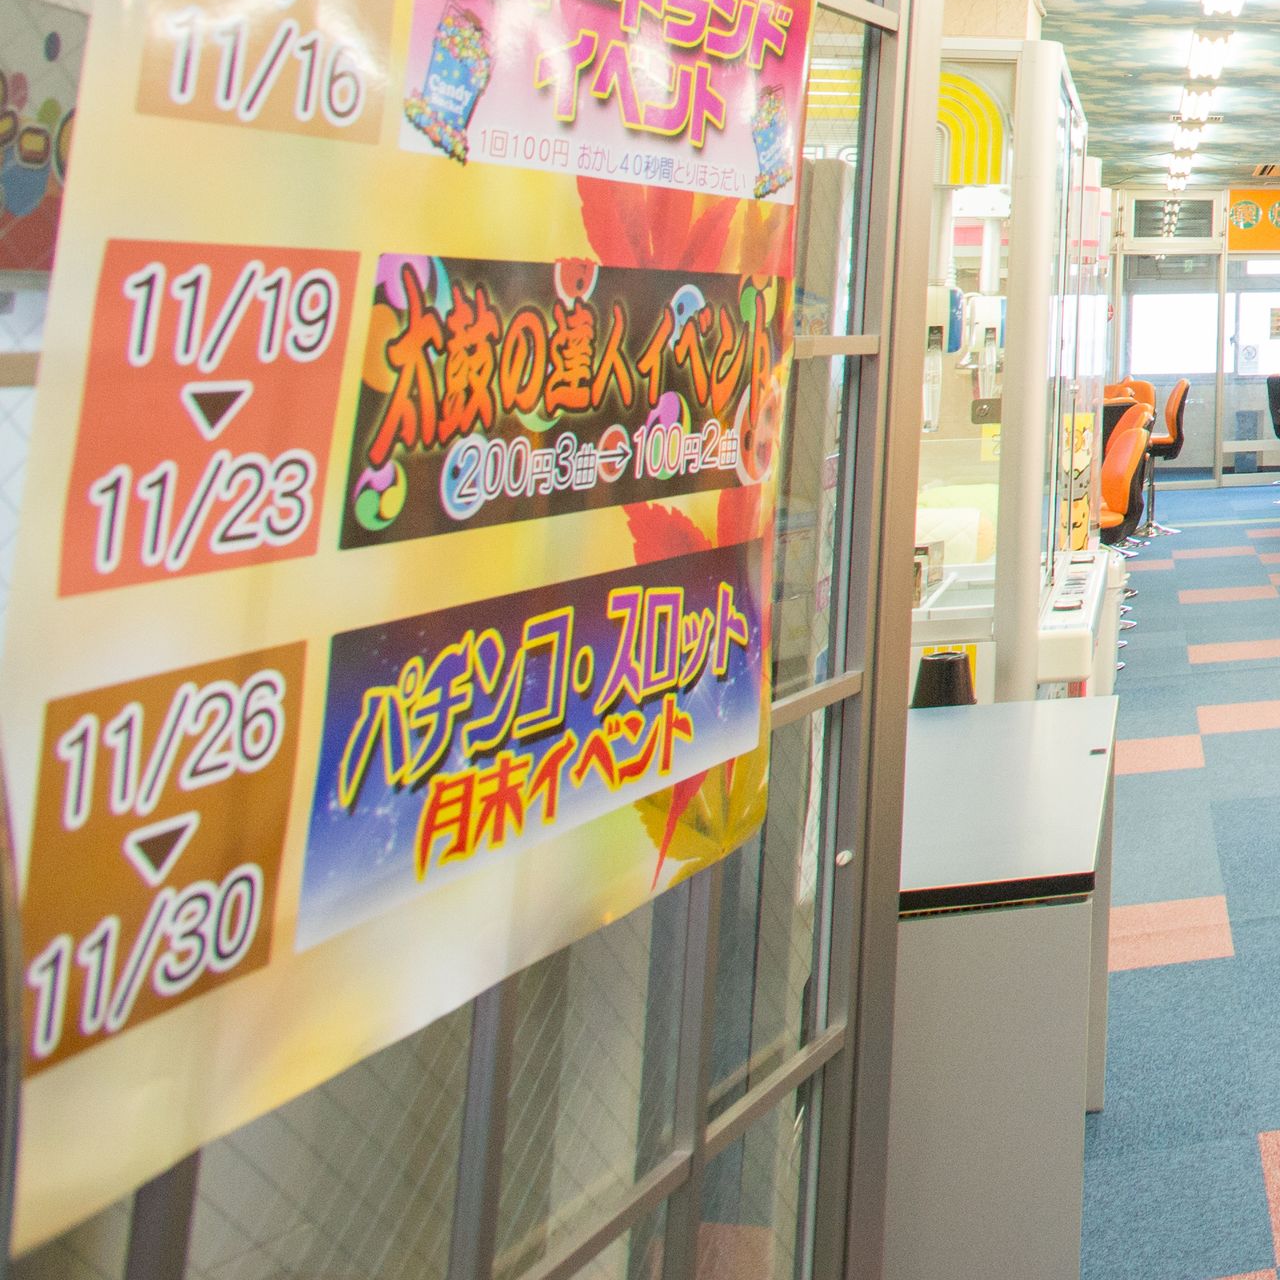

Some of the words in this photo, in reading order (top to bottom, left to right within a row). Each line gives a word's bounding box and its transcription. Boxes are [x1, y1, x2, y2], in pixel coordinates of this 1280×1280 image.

[166, 2, 368, 128] 11/16
[533, 28, 727, 148] イベント
[479, 129, 570, 169] 1回100円
[124, 261, 341, 373] 11/19
[366, 268, 778, 468] 太鼓の達人イベント
[89, 449, 317, 574] 11/23
[58, 668, 287, 831] 11/26
[339, 582, 750, 810] パチンコ・スロット
[414, 697, 694, 883] 月末イベント
[27, 862, 265, 1061] 11/30
